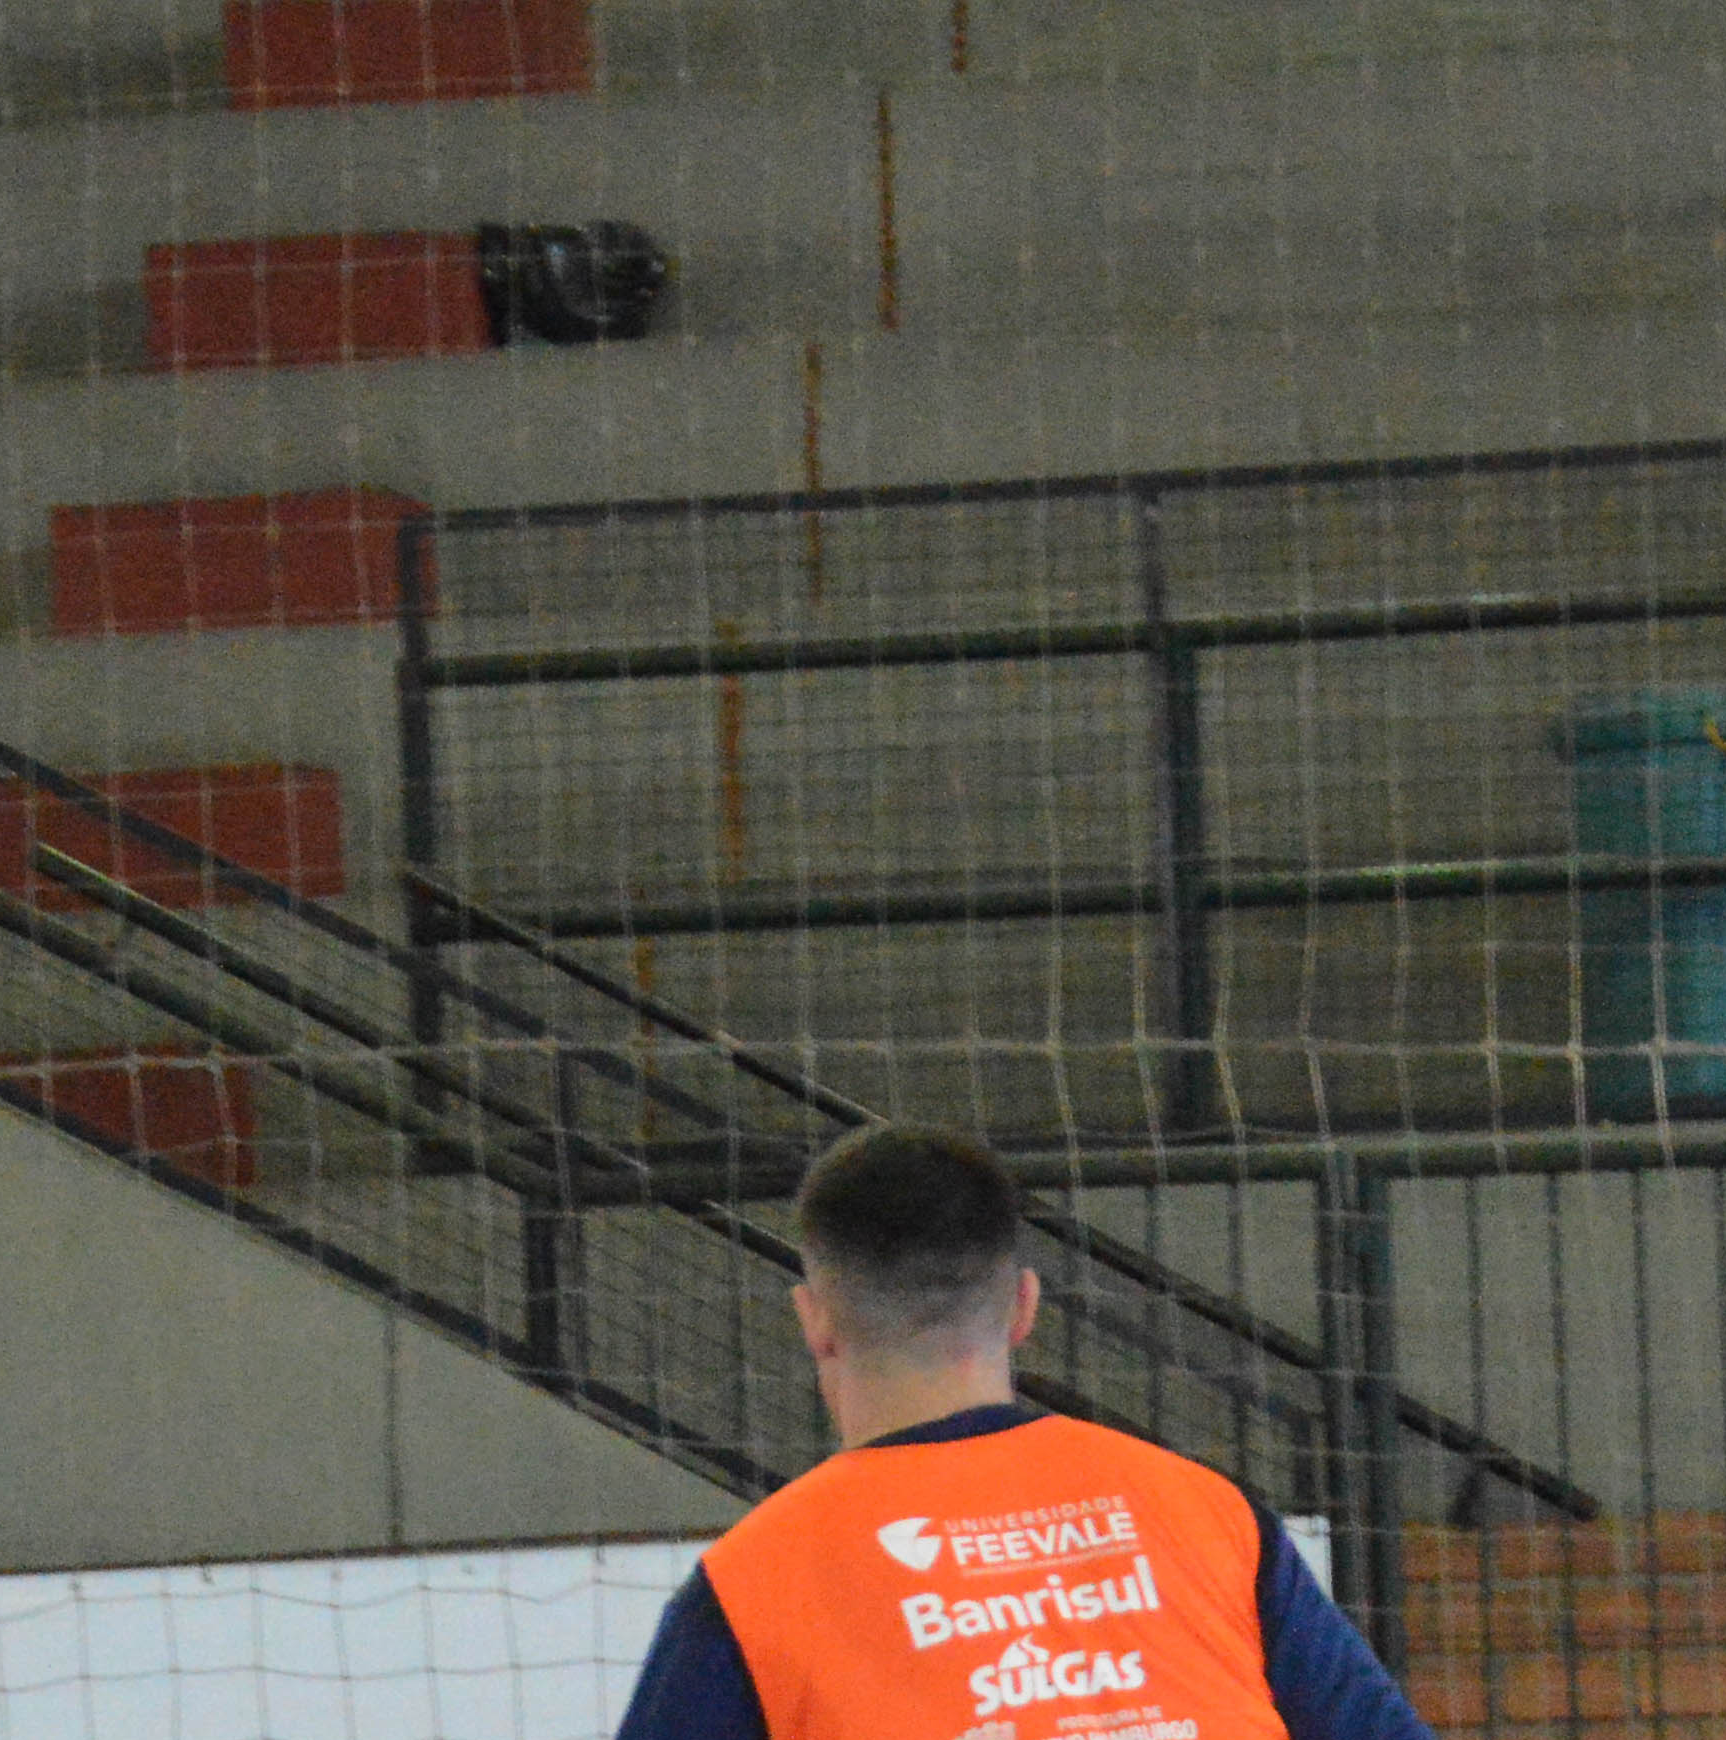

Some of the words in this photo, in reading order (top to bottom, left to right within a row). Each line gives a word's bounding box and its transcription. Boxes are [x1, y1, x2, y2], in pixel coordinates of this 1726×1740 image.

[944, 1496, 1125, 1533] UNIVERSIDADE
[951, 1511, 1138, 1565] FEEVALE
[900, 1554, 1161, 1651] Banrisul
